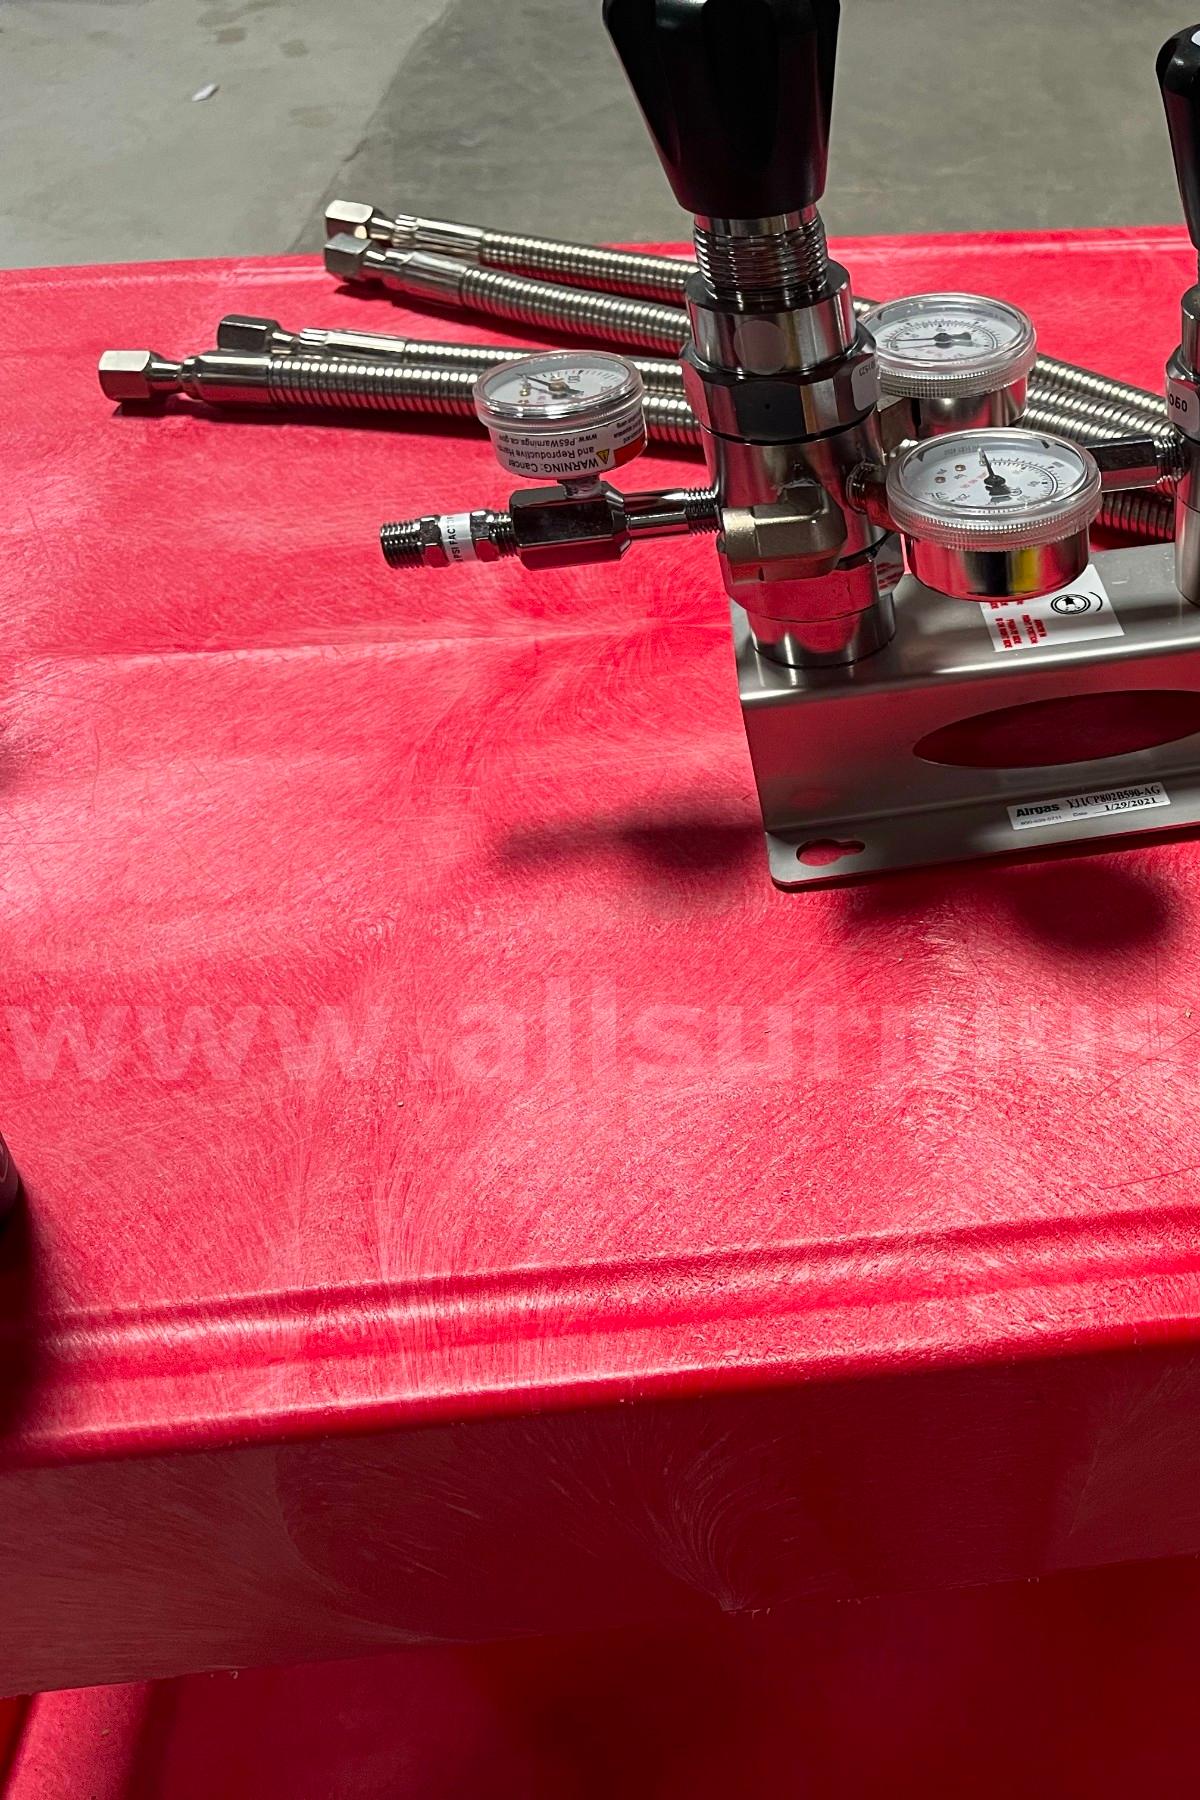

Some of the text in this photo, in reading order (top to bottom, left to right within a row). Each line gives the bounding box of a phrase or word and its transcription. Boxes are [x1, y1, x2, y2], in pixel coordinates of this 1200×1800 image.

[577, 446, 595, 457] and
[541, 458, 599, 473] WARNING:
[1016, 804, 1060, 817] Airgas
[1104, 797, 1156, 811] 1/29/2021
